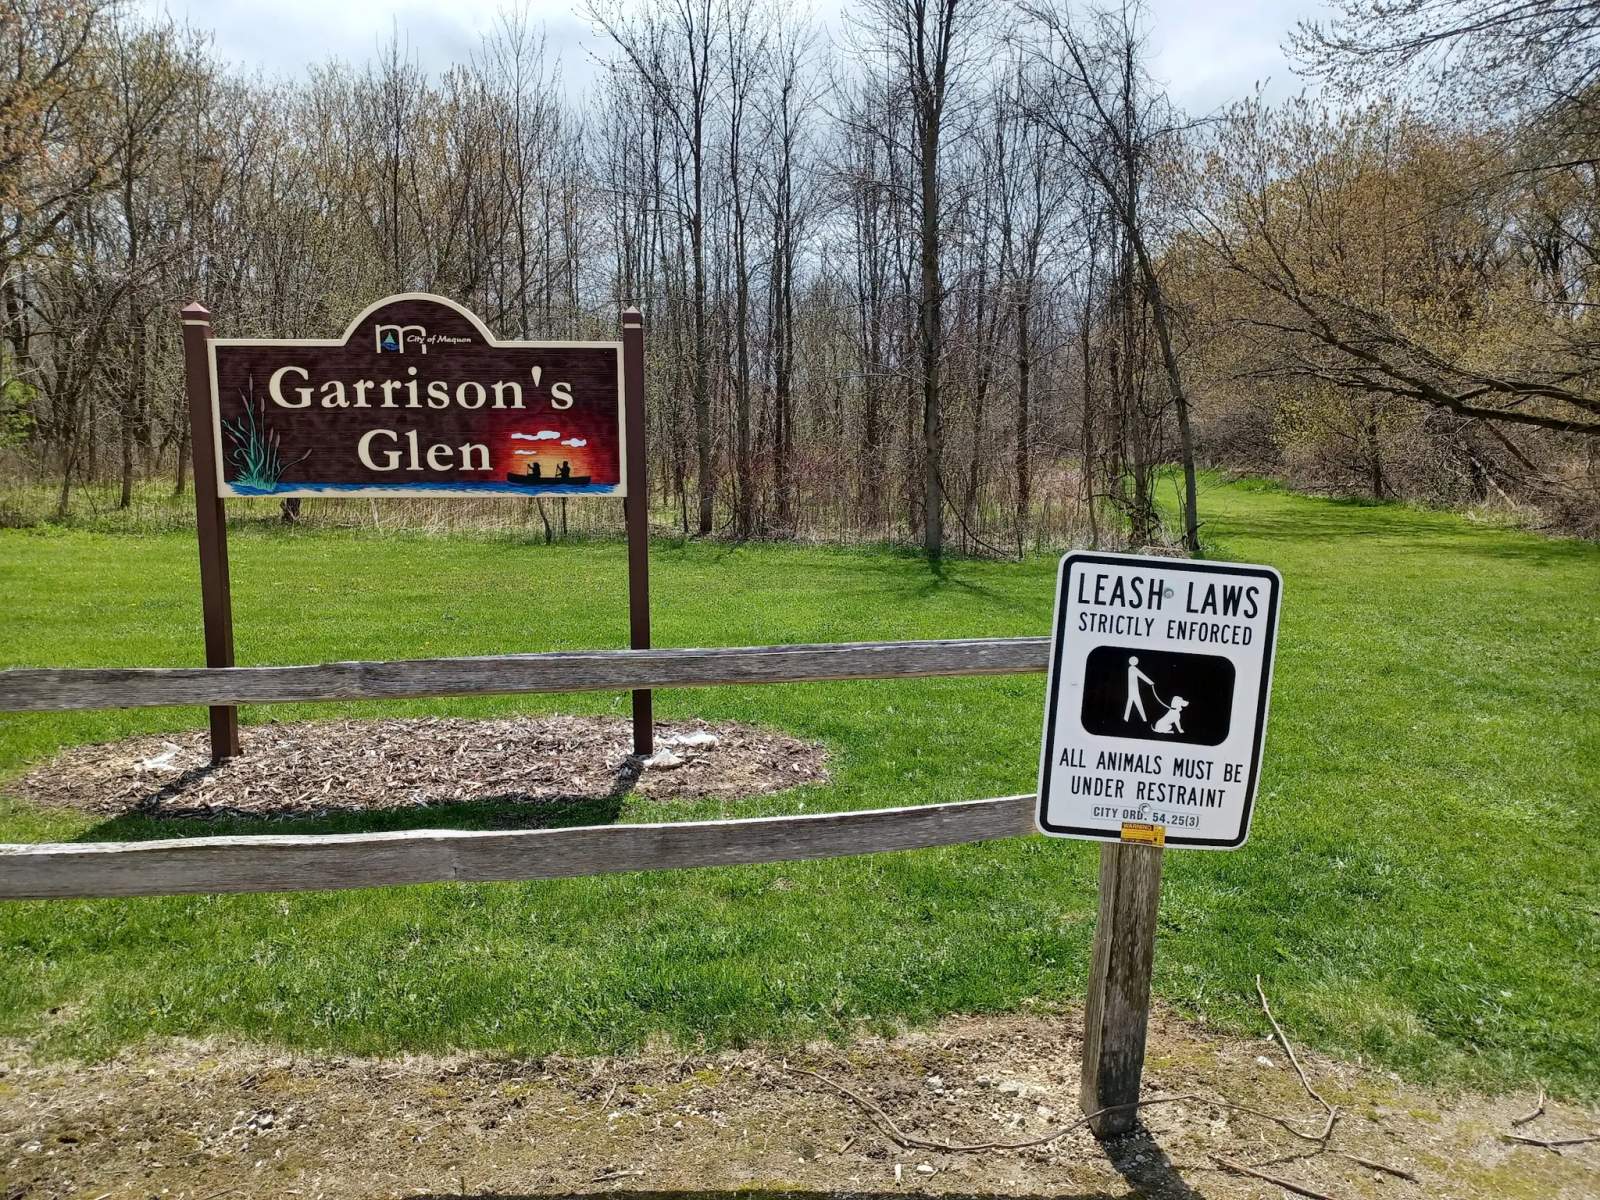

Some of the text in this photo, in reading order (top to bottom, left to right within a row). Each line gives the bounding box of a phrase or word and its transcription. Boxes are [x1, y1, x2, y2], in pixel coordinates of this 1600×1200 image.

[407, 335, 425, 344] City
[427, 335, 436, 344] of
[268, 366, 575, 410] Garrison's
[357, 428, 494, 472] Glen
[1077, 573, 1260, 619] LEASH LAWS
[1078, 611, 1253, 646] STRICTLY ENFORCED
[1059, 748, 1244, 783] ALL ANIMALS MUST BE
[1071, 775, 1226, 808] UNDER RESTRAINT
[1093, 806, 1119, 819] CITY
[1152, 811, 1200, 828] 54.25(3)
